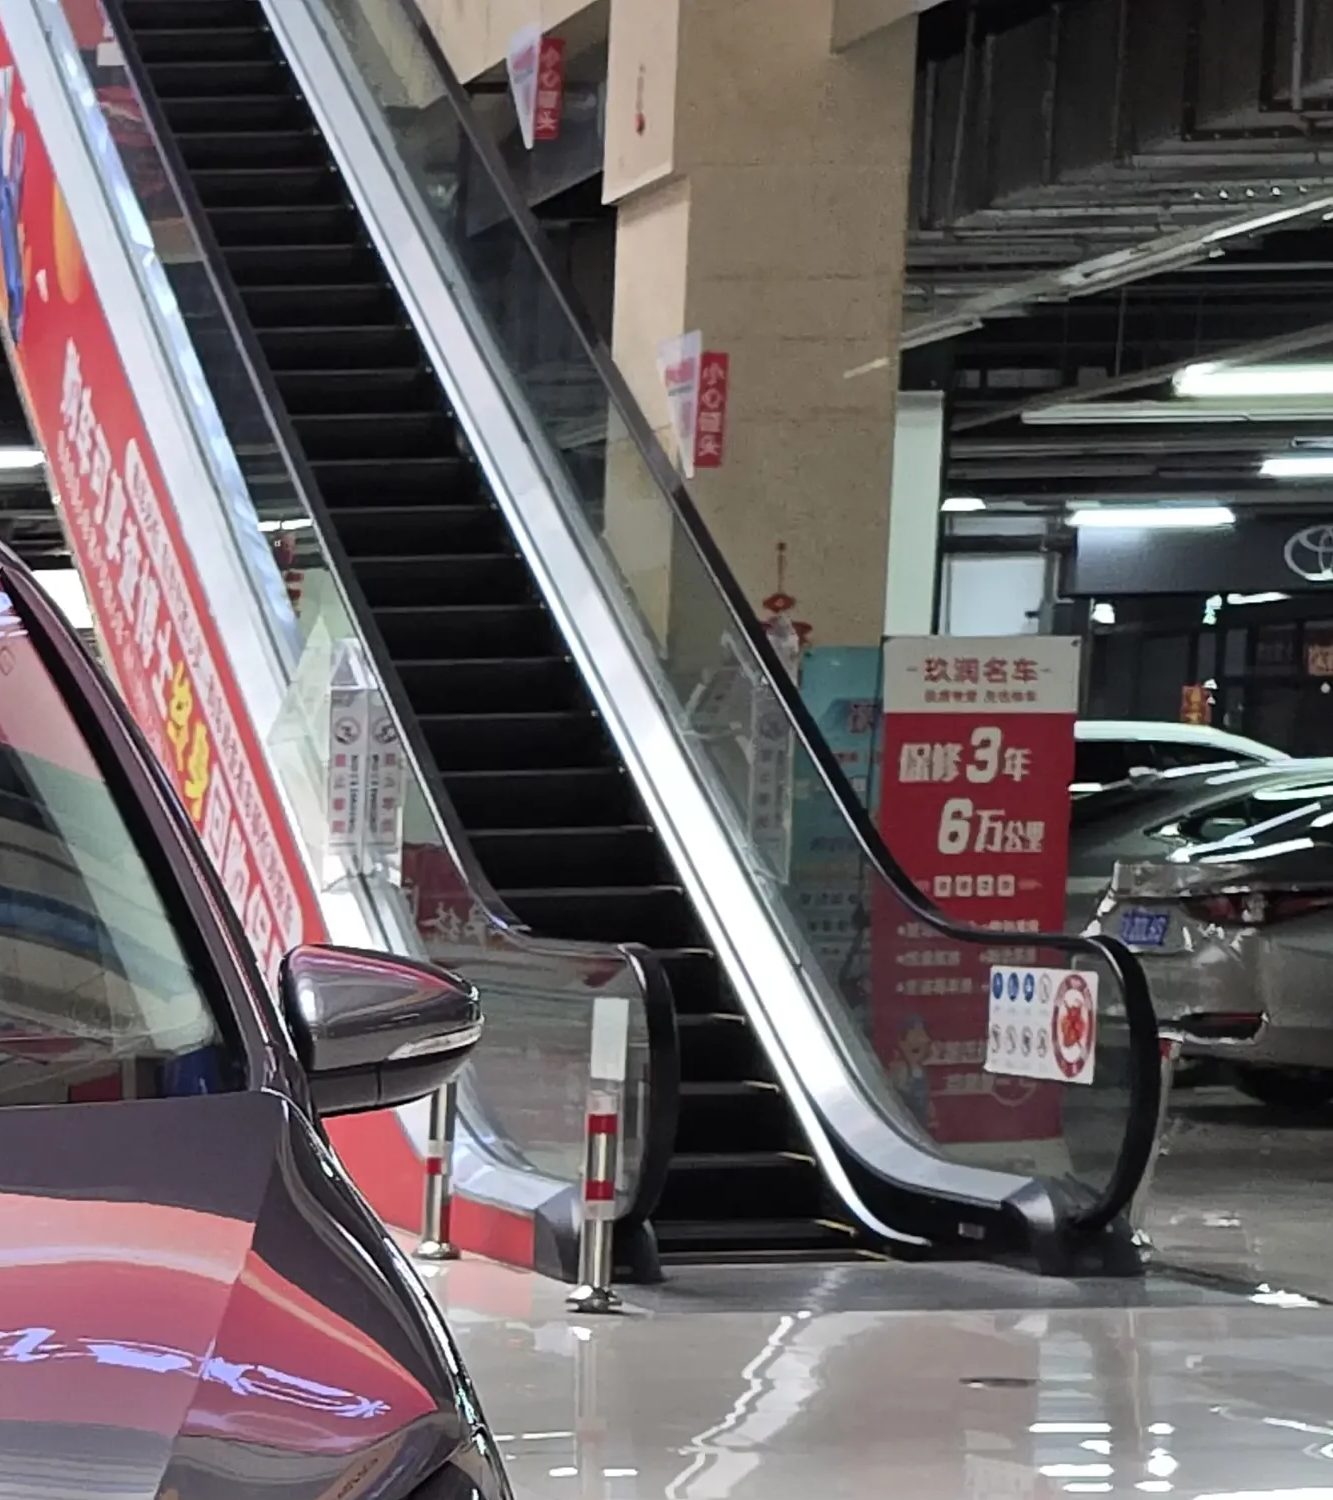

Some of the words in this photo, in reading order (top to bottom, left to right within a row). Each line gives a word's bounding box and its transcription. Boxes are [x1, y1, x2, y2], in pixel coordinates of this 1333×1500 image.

[899, 726, 1032, 784] 保修3年
[937, 797, 1045, 855] 6万公里
